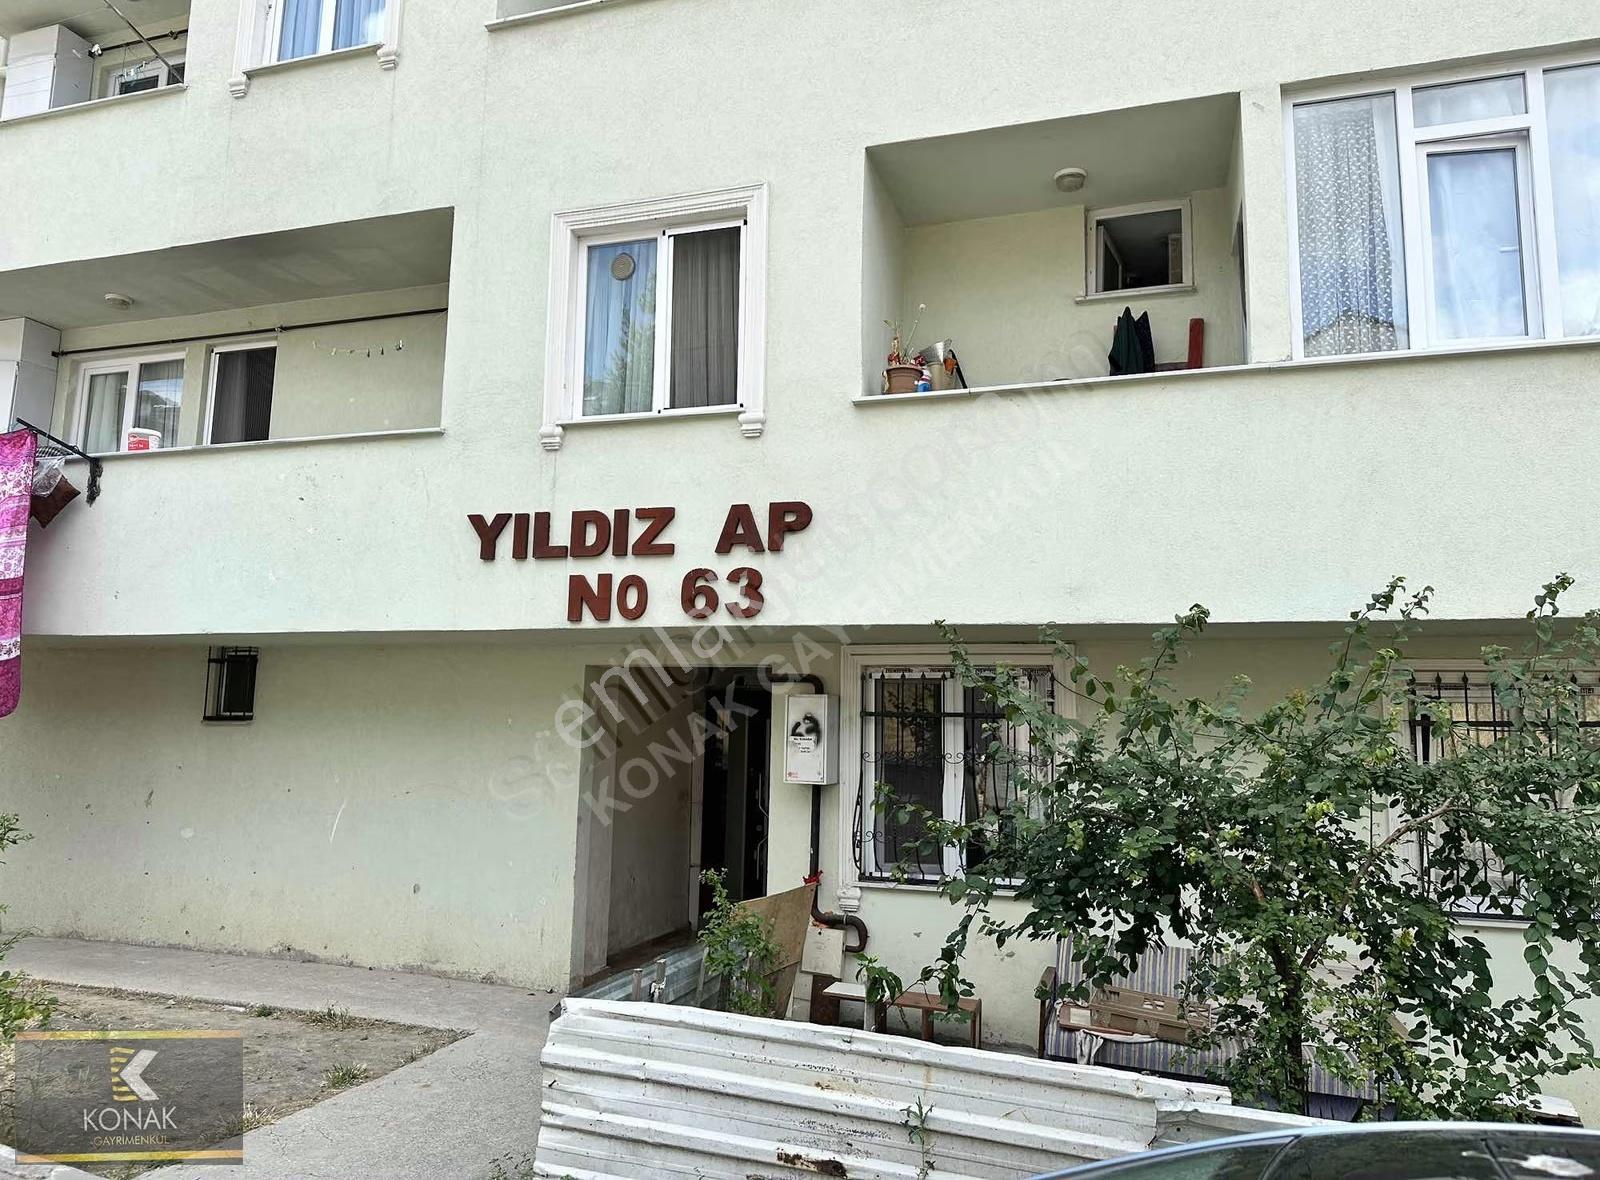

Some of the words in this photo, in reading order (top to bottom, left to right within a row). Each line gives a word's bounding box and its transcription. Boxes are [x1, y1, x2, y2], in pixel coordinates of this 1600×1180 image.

[467, 507, 675, 560] YILDIZ
[715, 501, 813, 553] AP
[681, 567, 765, 619] 63
